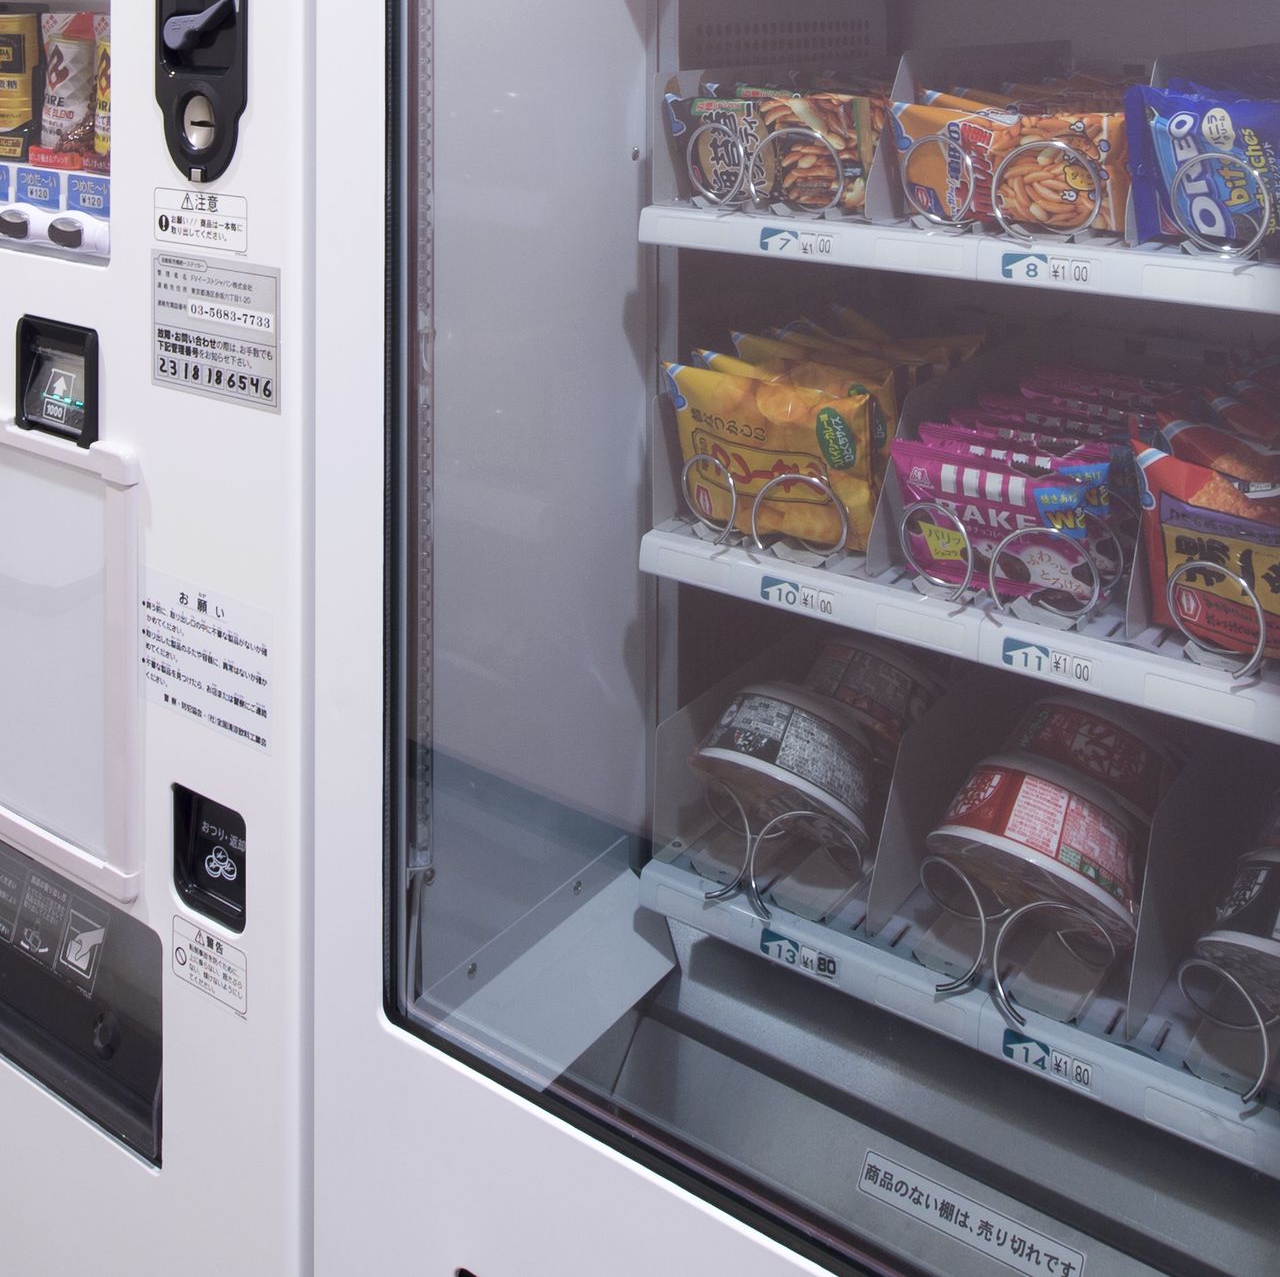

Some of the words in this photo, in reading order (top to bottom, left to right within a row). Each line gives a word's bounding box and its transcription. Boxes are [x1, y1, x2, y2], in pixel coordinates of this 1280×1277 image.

[29, 188, 49, 200] ¥120
[81, 195, 103, 207] ¥120
[195, 194, 219, 213] 注意
[778, 237, 792, 251] 7
[1025, 263, 1039, 279] 8
[190, 302, 271, 329] 03-5683-7733
[46, 403, 63, 418] 1000
[934, 497, 1038, 530] BAKE
[926, 527, 961, 545] パリッ
[775, 586, 797, 605] 10
[1021, 650, 1043, 671] 11
[775, 942, 797, 964] 13
[1022, 1046, 1048, 1072] 14
